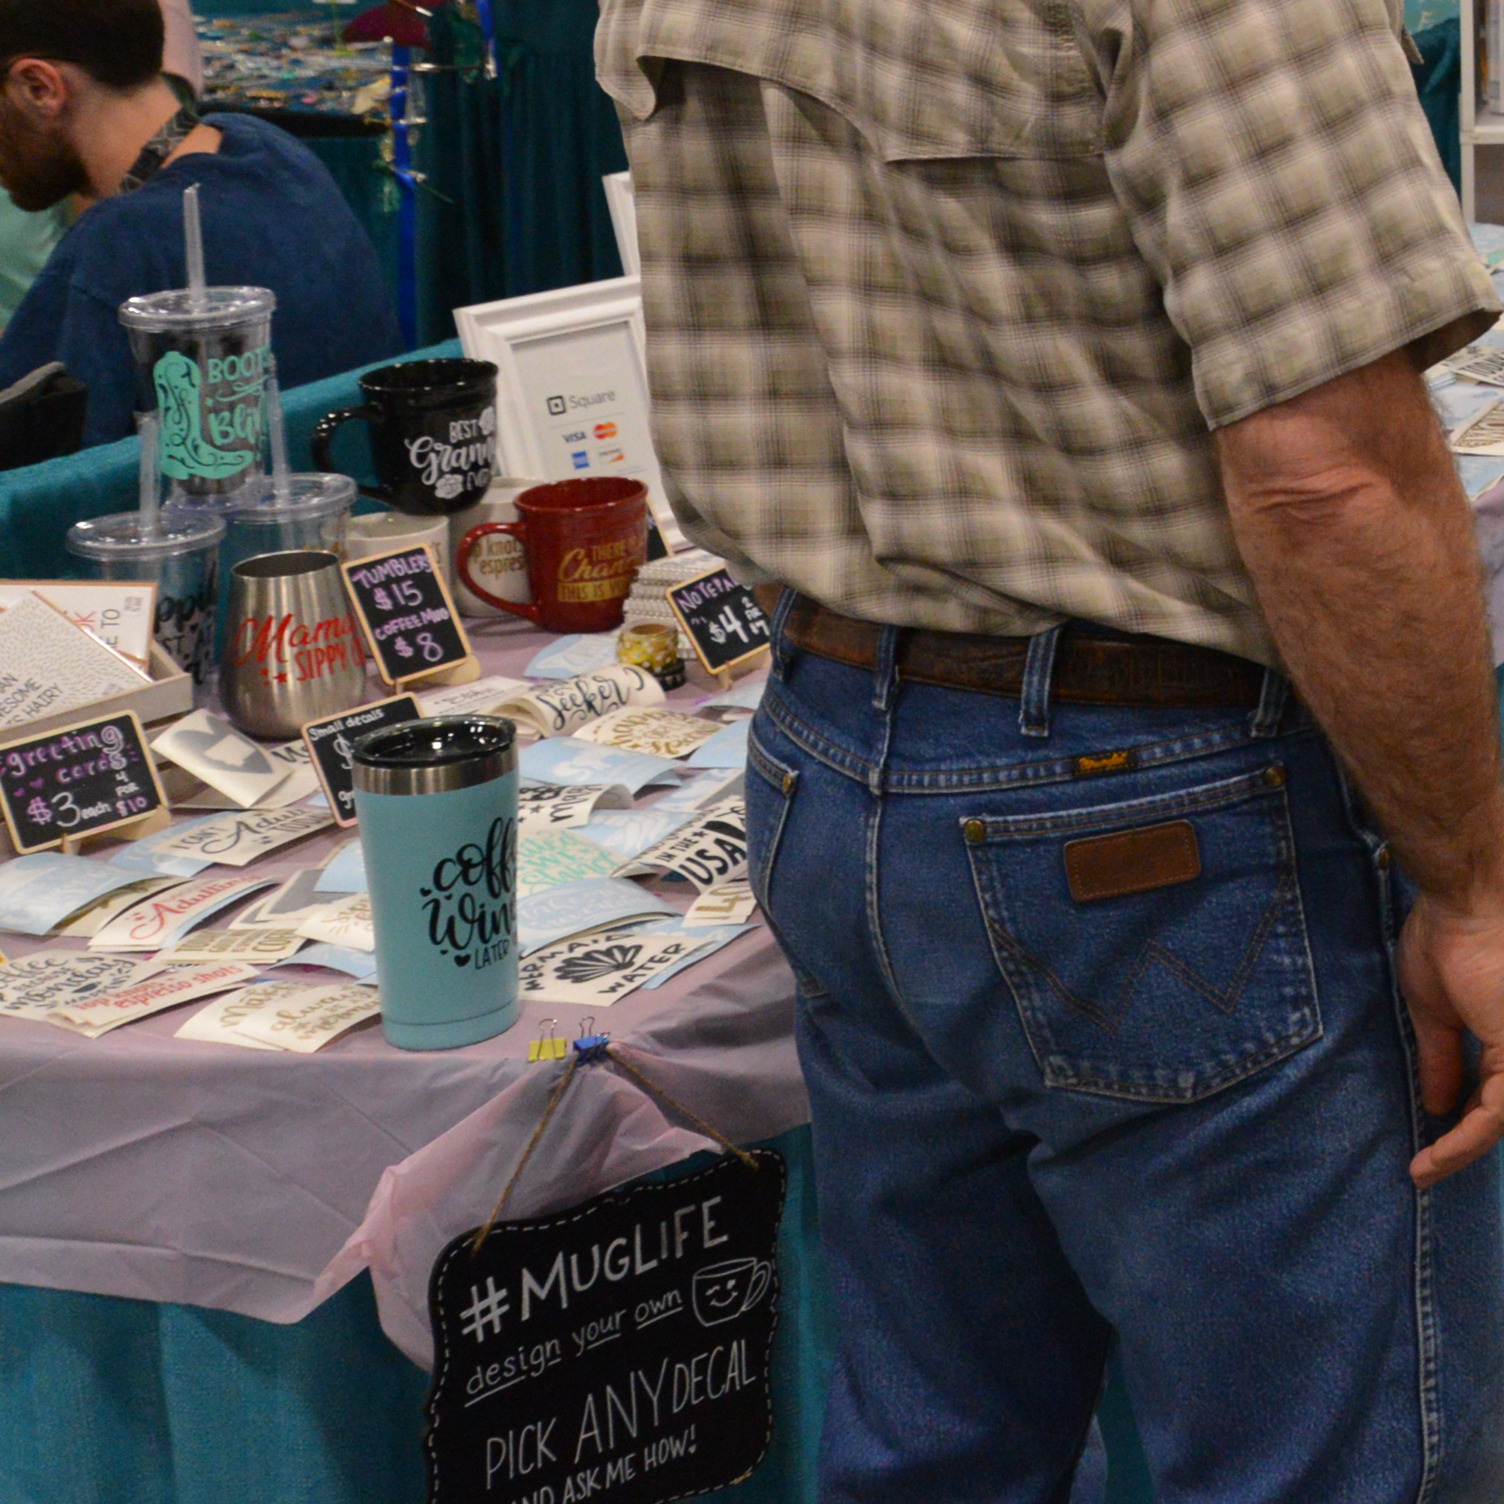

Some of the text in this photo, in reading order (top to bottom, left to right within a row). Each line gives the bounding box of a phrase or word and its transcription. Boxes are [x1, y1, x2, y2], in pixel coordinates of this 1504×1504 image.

[568, 390, 617, 410] Square
[449, 418, 478, 444] BEST
[562, 430, 587, 445] VISA
[351, 552, 434, 589] TUMBLERS
[373, 580, 423, 612] $15
[234, 612, 357, 667] Mama
[373, 616, 421, 641] COFFEE
[708, 605, 749, 644] $4
[295, 641, 347, 683] SIPPY
[394, 631, 444, 663] $8
[536, 674, 632, 730] Seeker
[308, 708, 386, 742] Small decals
[4, 724, 124, 779] greeting
[55, 751, 128, 785] cards
[115, 770, 129, 783] 4
[115, 782, 140, 797] FOR
[26, 790, 113, 828] $3 each
[115, 795, 148, 817] $10
[672, 834, 699, 854] THE
[678, 837, 748, 886] USA
[474, 939, 510, 970] LATER
[598, 942, 688, 995] WATER
[459, 1195, 729, 1344] #MUGLIFE
[465, 1287, 684, 1396] design your own
[486, 1338, 757, 1491] PICK ANY DECAL
[562, 1467, 602, 1504] ASK
[604, 1452, 637, 1489] ME
